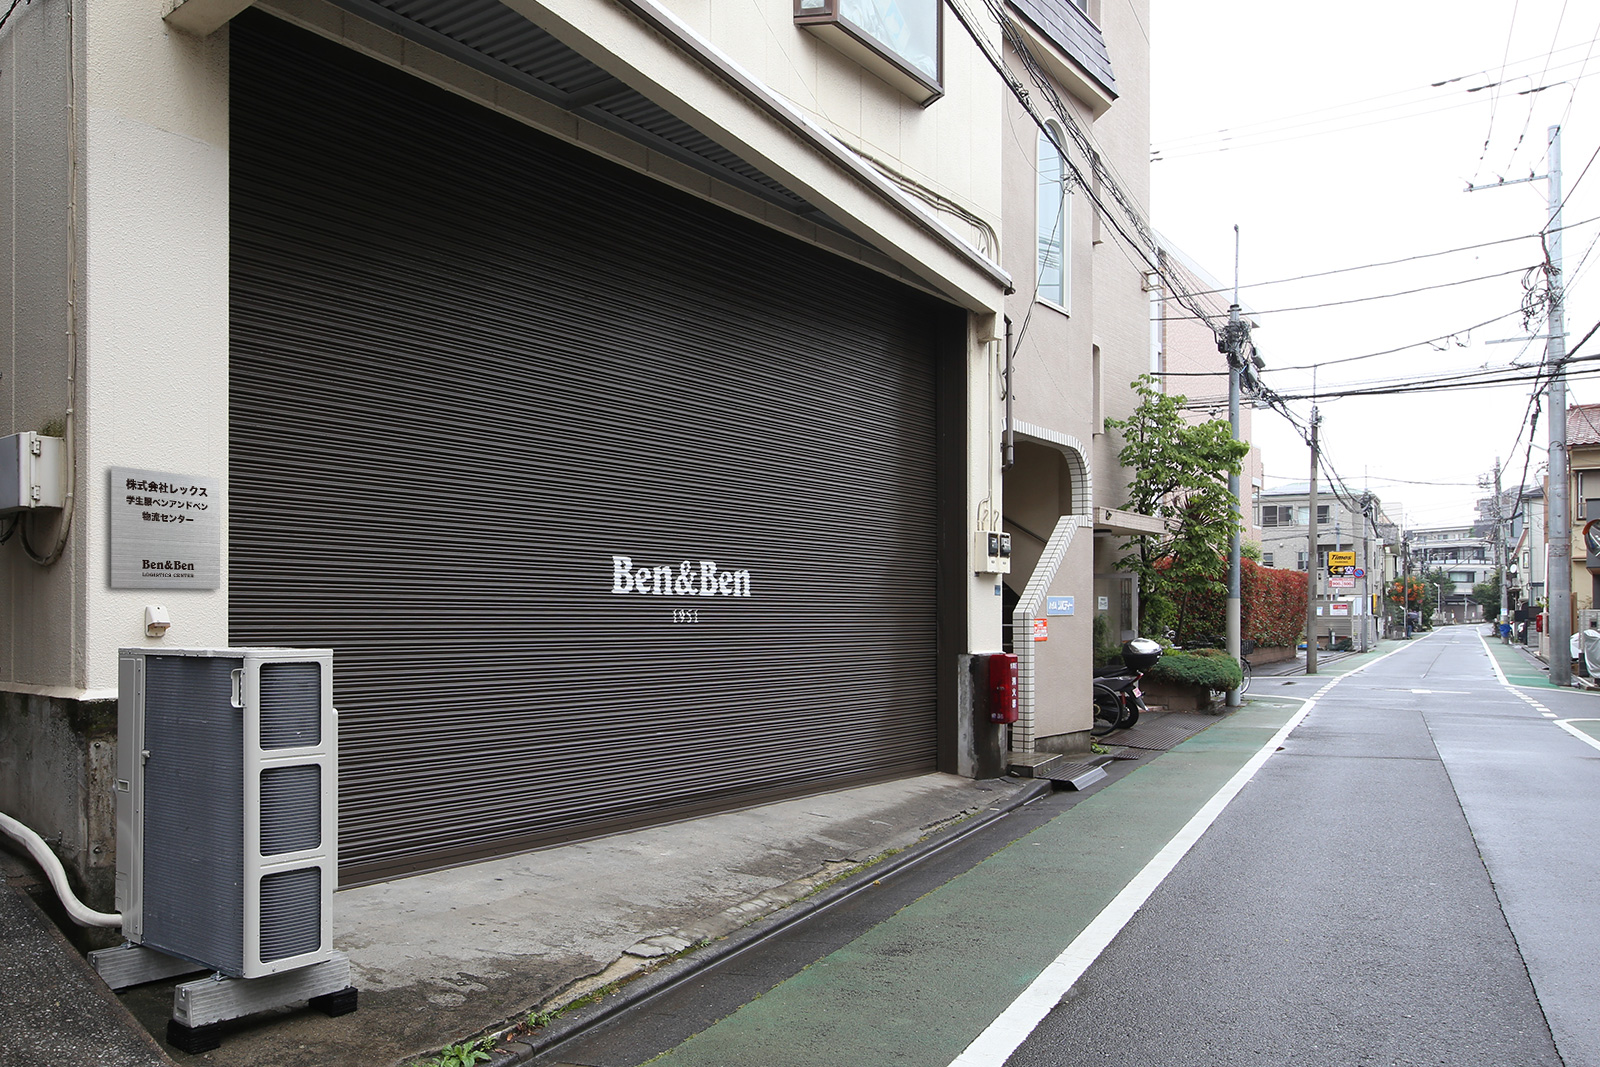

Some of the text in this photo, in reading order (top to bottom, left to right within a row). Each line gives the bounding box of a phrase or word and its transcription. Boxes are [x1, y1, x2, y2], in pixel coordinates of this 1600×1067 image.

[126, 478, 208, 497] 株式会社レックス
[126, 495, 208, 511] 学生服ベンアンドベン
[142, 511, 194, 523] 物流センター
[142, 559, 195, 571] Ben&Ben
[611, 555, 751, 597] Ben&Ben
[673, 608, 699, 623] 1951
